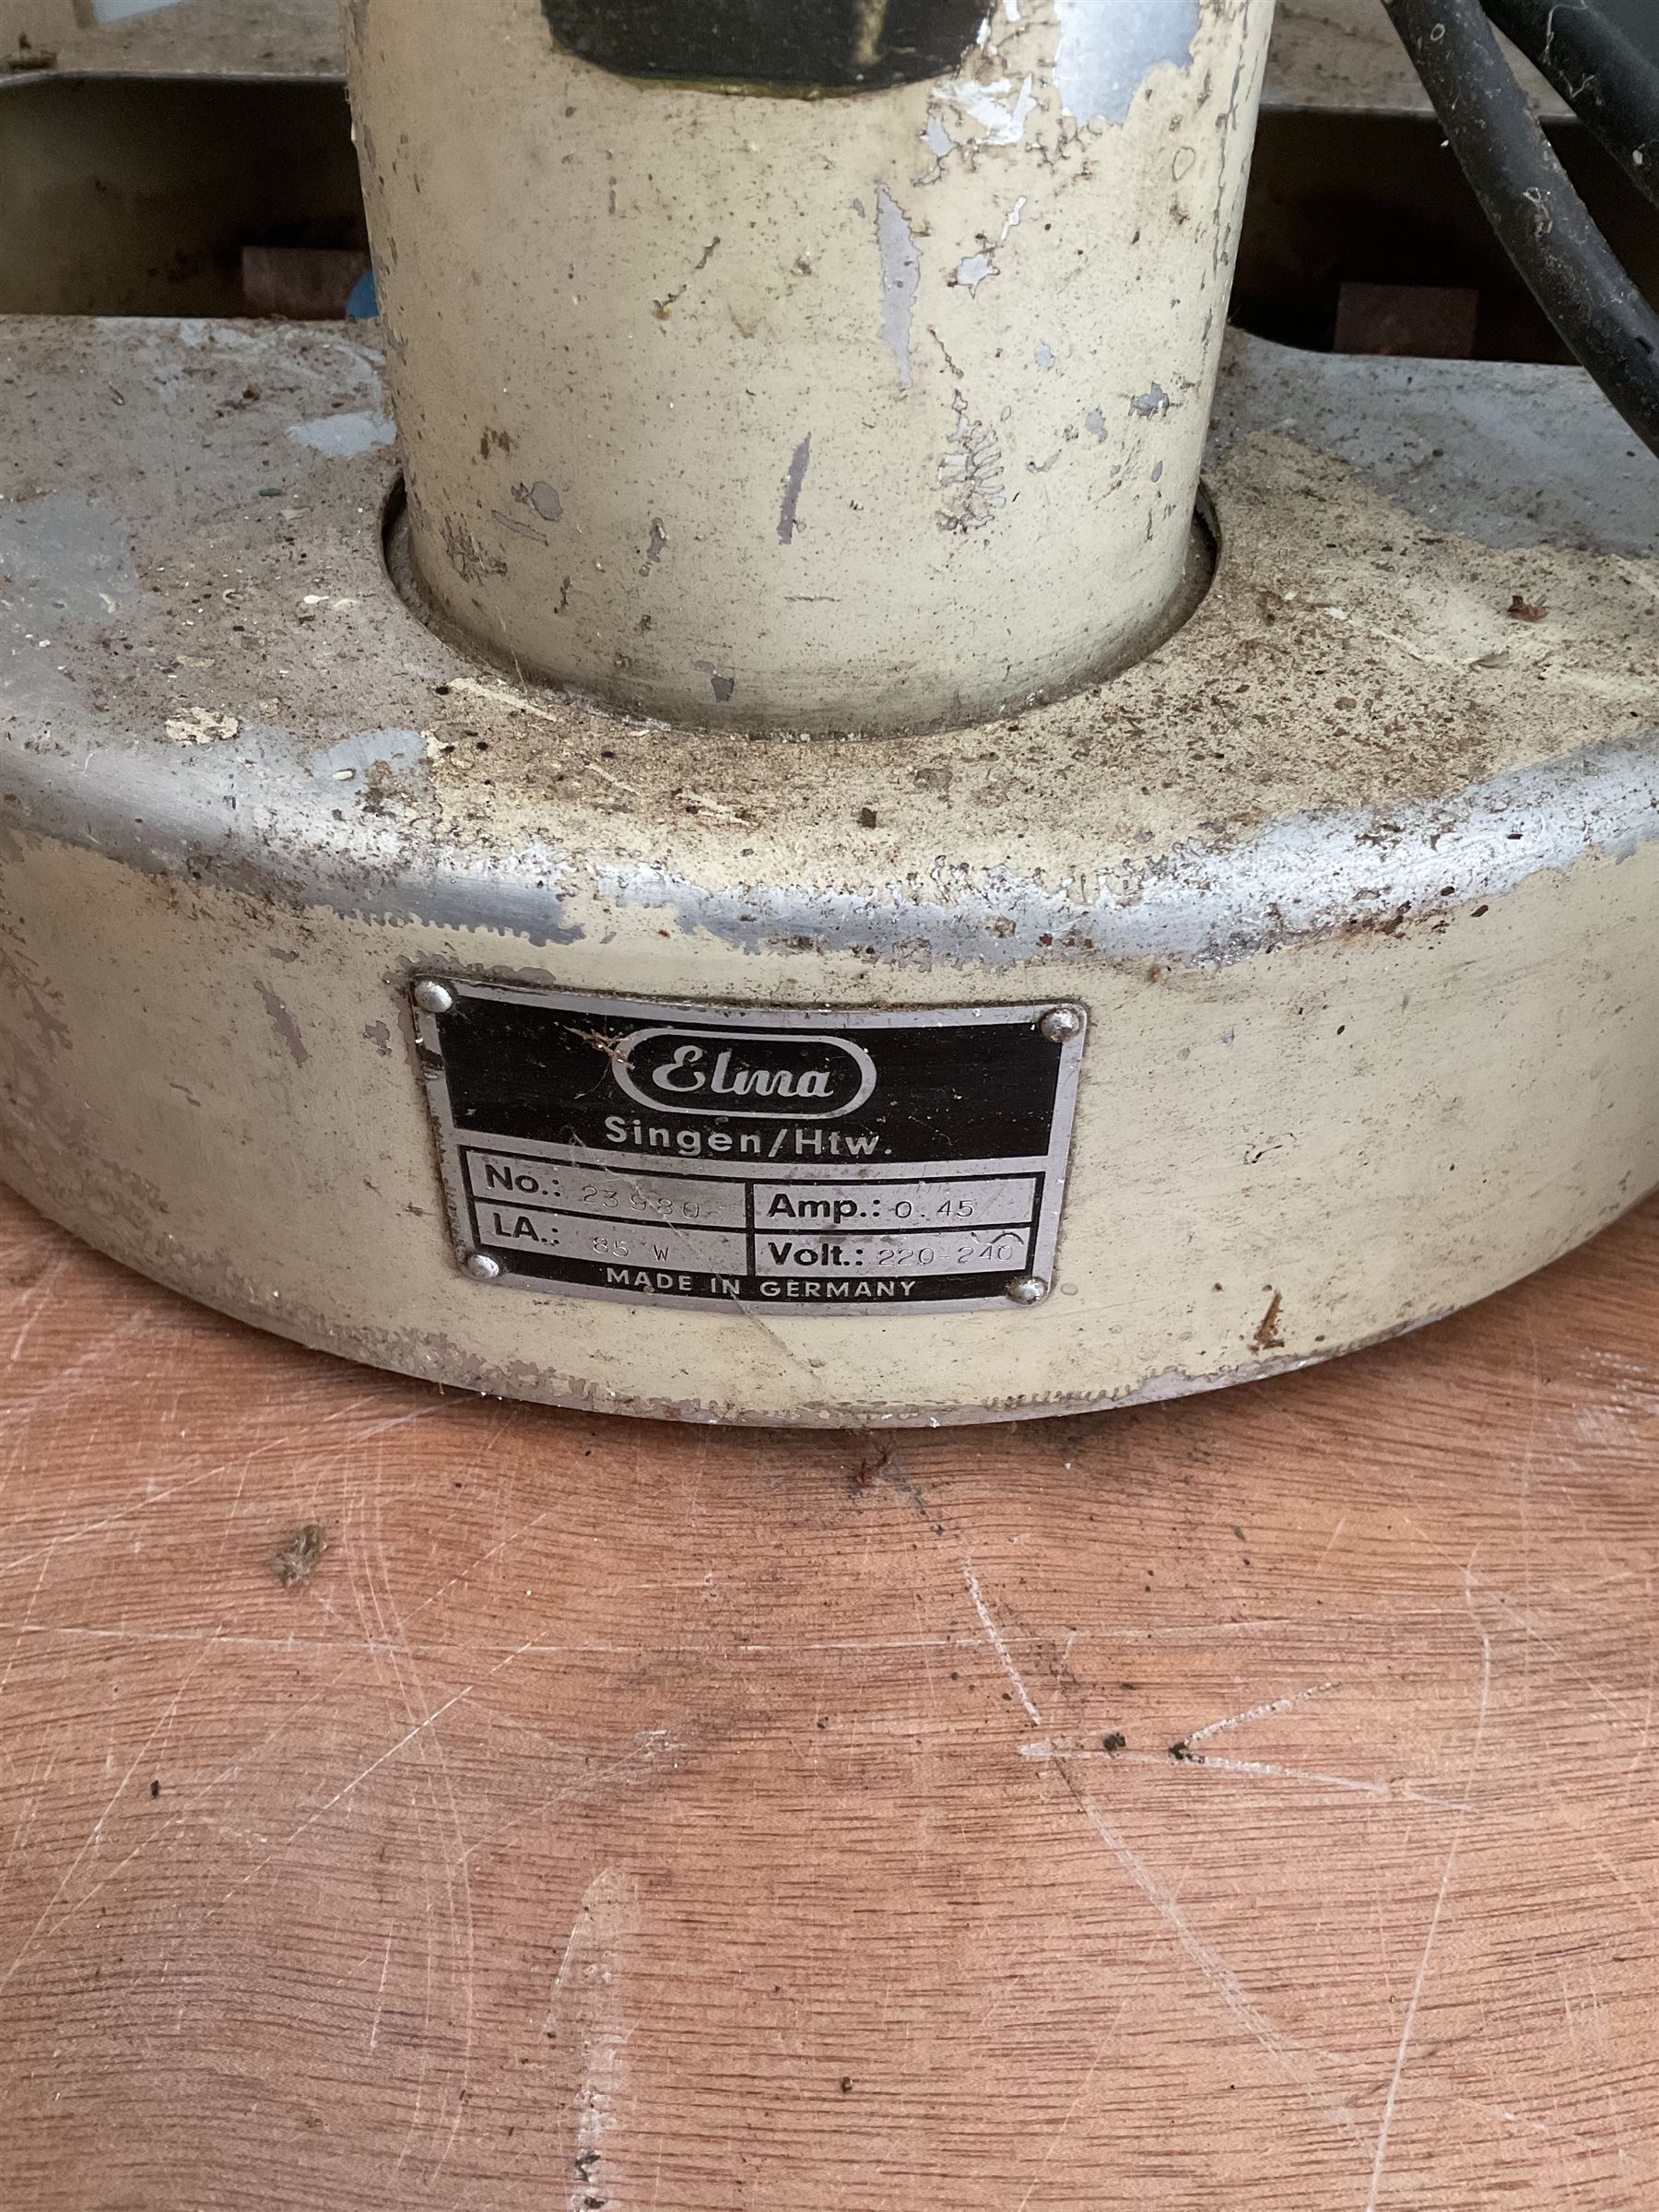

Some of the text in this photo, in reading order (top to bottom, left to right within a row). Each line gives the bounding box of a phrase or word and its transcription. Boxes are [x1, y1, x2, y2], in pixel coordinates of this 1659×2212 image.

[652, 1044, 834, 1098] Elma
[605, 1116, 892, 1158] Singen/Htw.
[485, 1164, 560, 1197] No.:
[768, 1193, 880, 1223] Amp.:
[493, 1213, 559, 1246] LA.:
[653, 1244, 669, 1262] W
[768, 1241, 864, 1265] Volt.:
[606, 1267, 916, 1298] MADE IN GERMANY
